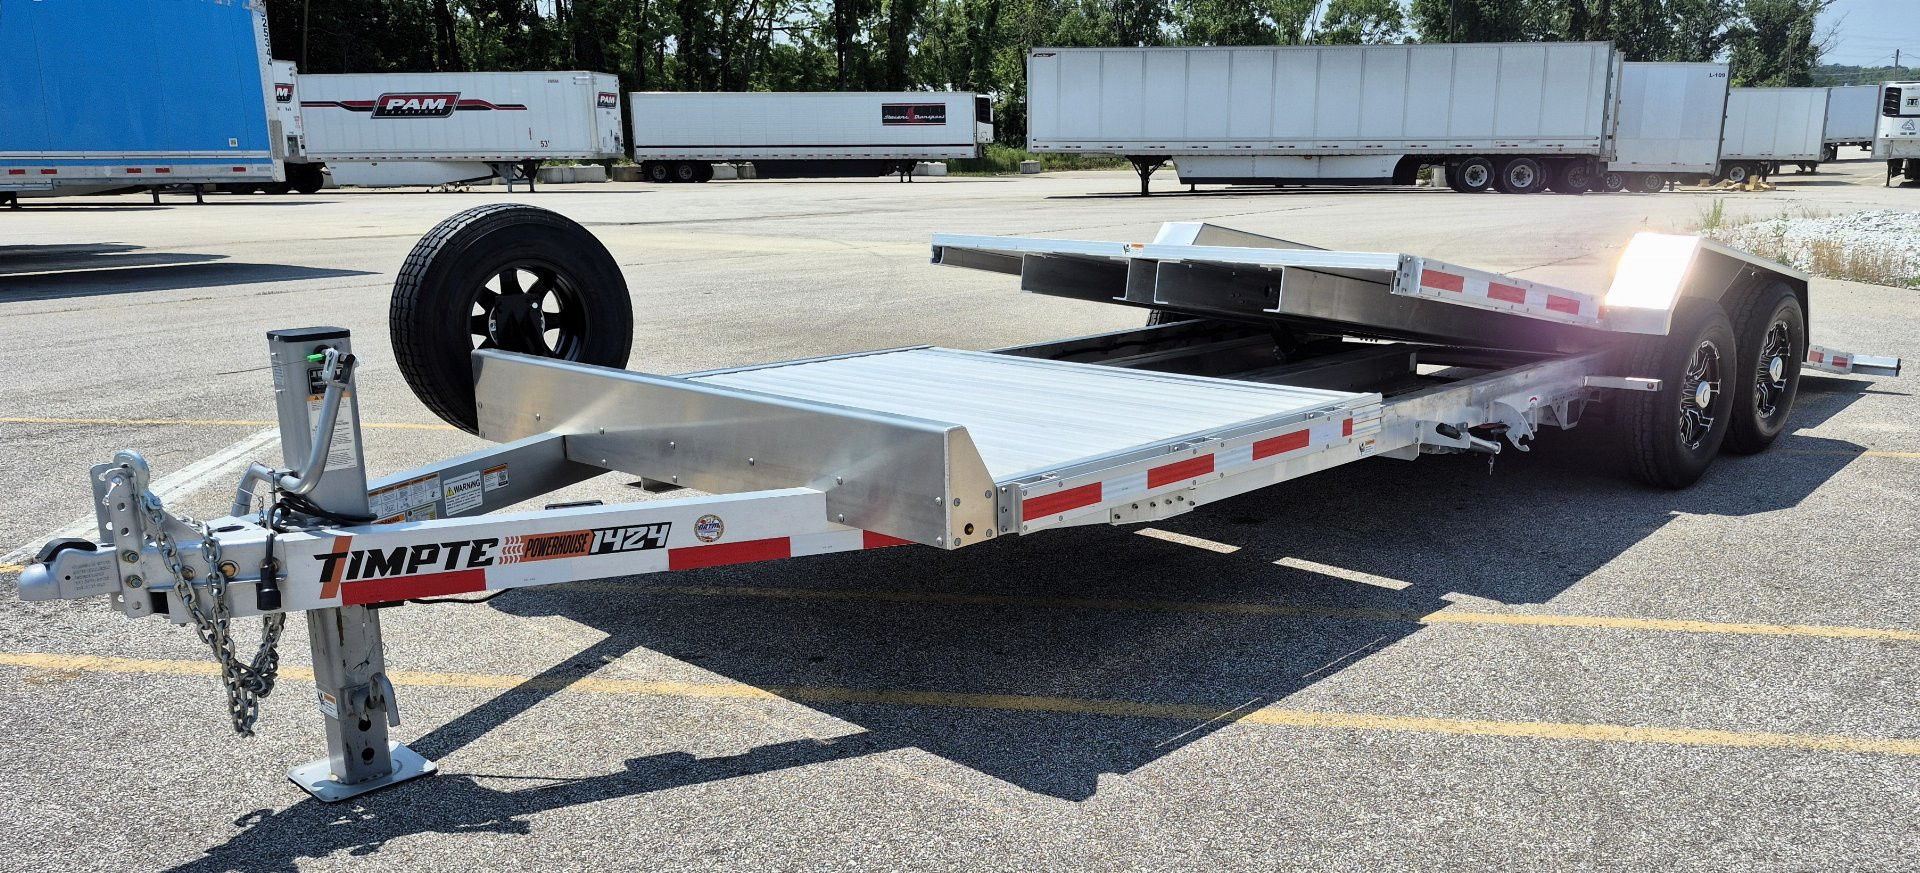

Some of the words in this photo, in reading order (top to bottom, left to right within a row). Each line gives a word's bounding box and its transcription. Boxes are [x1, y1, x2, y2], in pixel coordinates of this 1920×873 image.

[386, 98, 447, 110] PAM
[600, 95, 615, 104] PAM
[453, 479, 481, 494] WARNING
[524, 532, 590, 559] POWERHOUSE
[591, 524, 670, 555] 1424
[313, 538, 500, 583] TIMPTE
